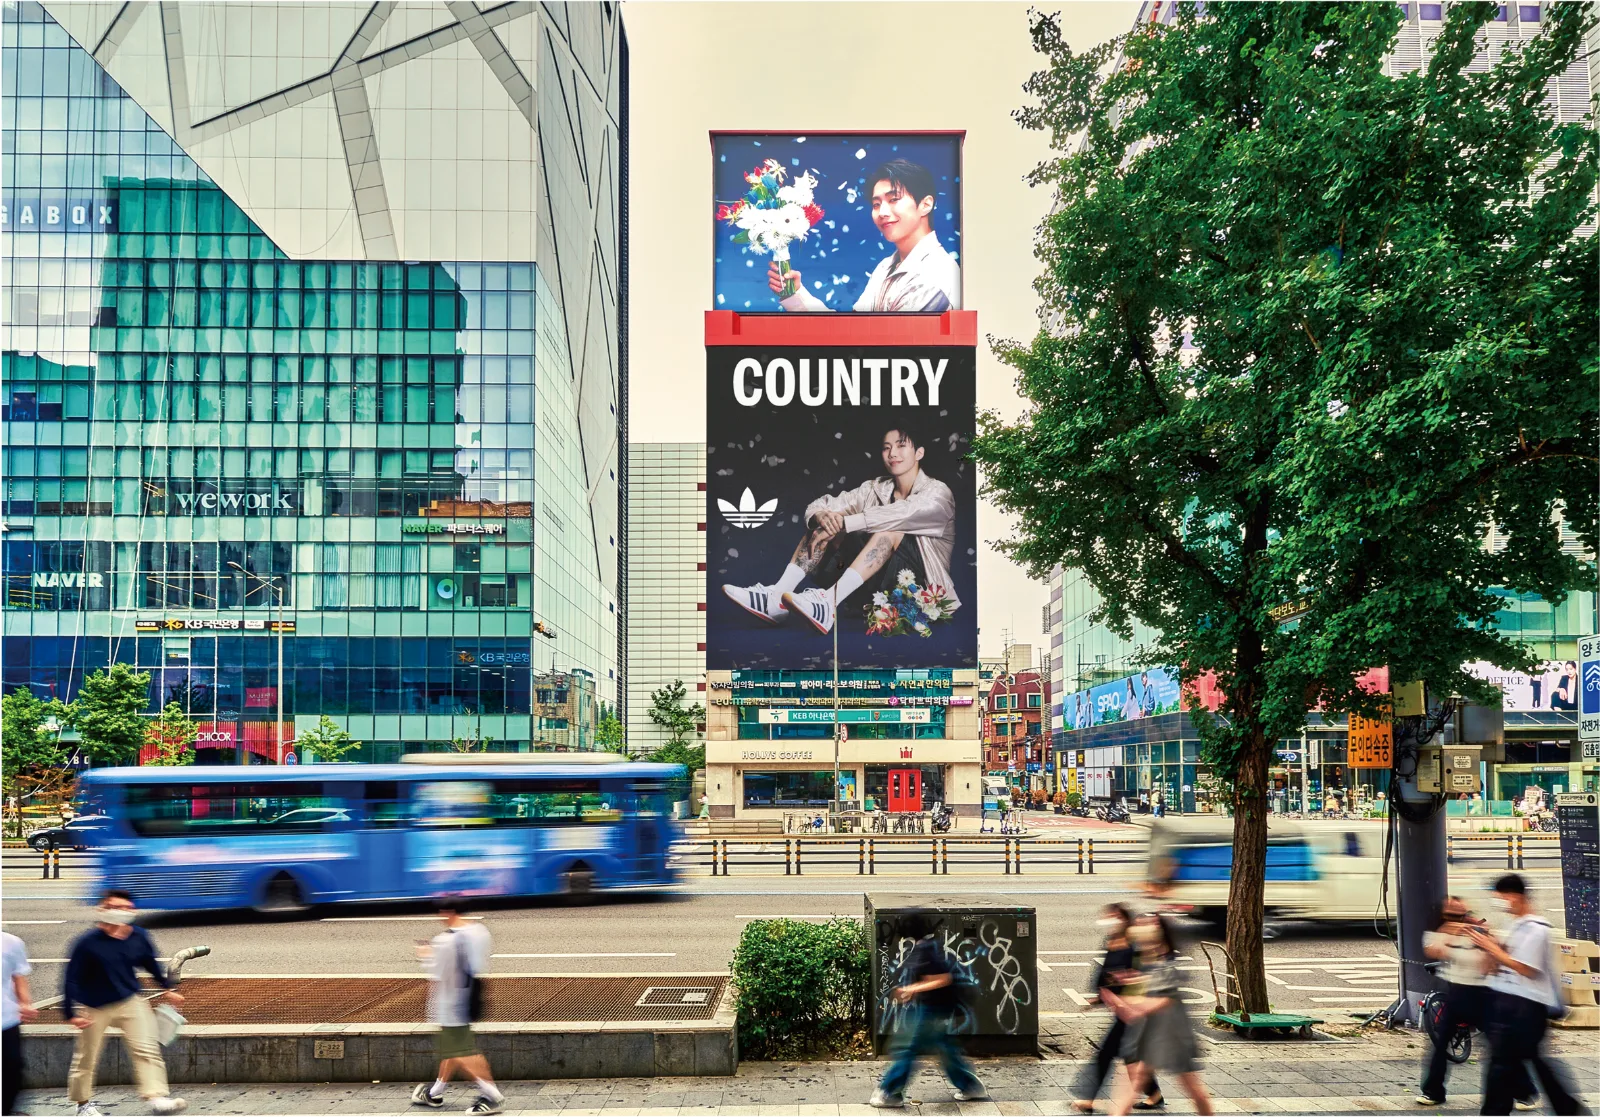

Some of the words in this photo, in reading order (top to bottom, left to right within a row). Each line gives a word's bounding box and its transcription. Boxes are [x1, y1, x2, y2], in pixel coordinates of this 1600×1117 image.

[733, 358, 949, 406] COUNTRY
[175, 491, 293, 509] wework
[402, 523, 443, 533] NAVER
[447, 523, 503, 534] 파트너스퀘어
[34, 573, 104, 588] NAVER
[184, 619, 240, 629] KB국민은행
[1098, 692, 1119, 712] SPAO
[741, 751, 777, 759] HOLLYS
[779, 751, 813, 759] COFFEE
[1350, 734, 1389, 762] 무인단속중
